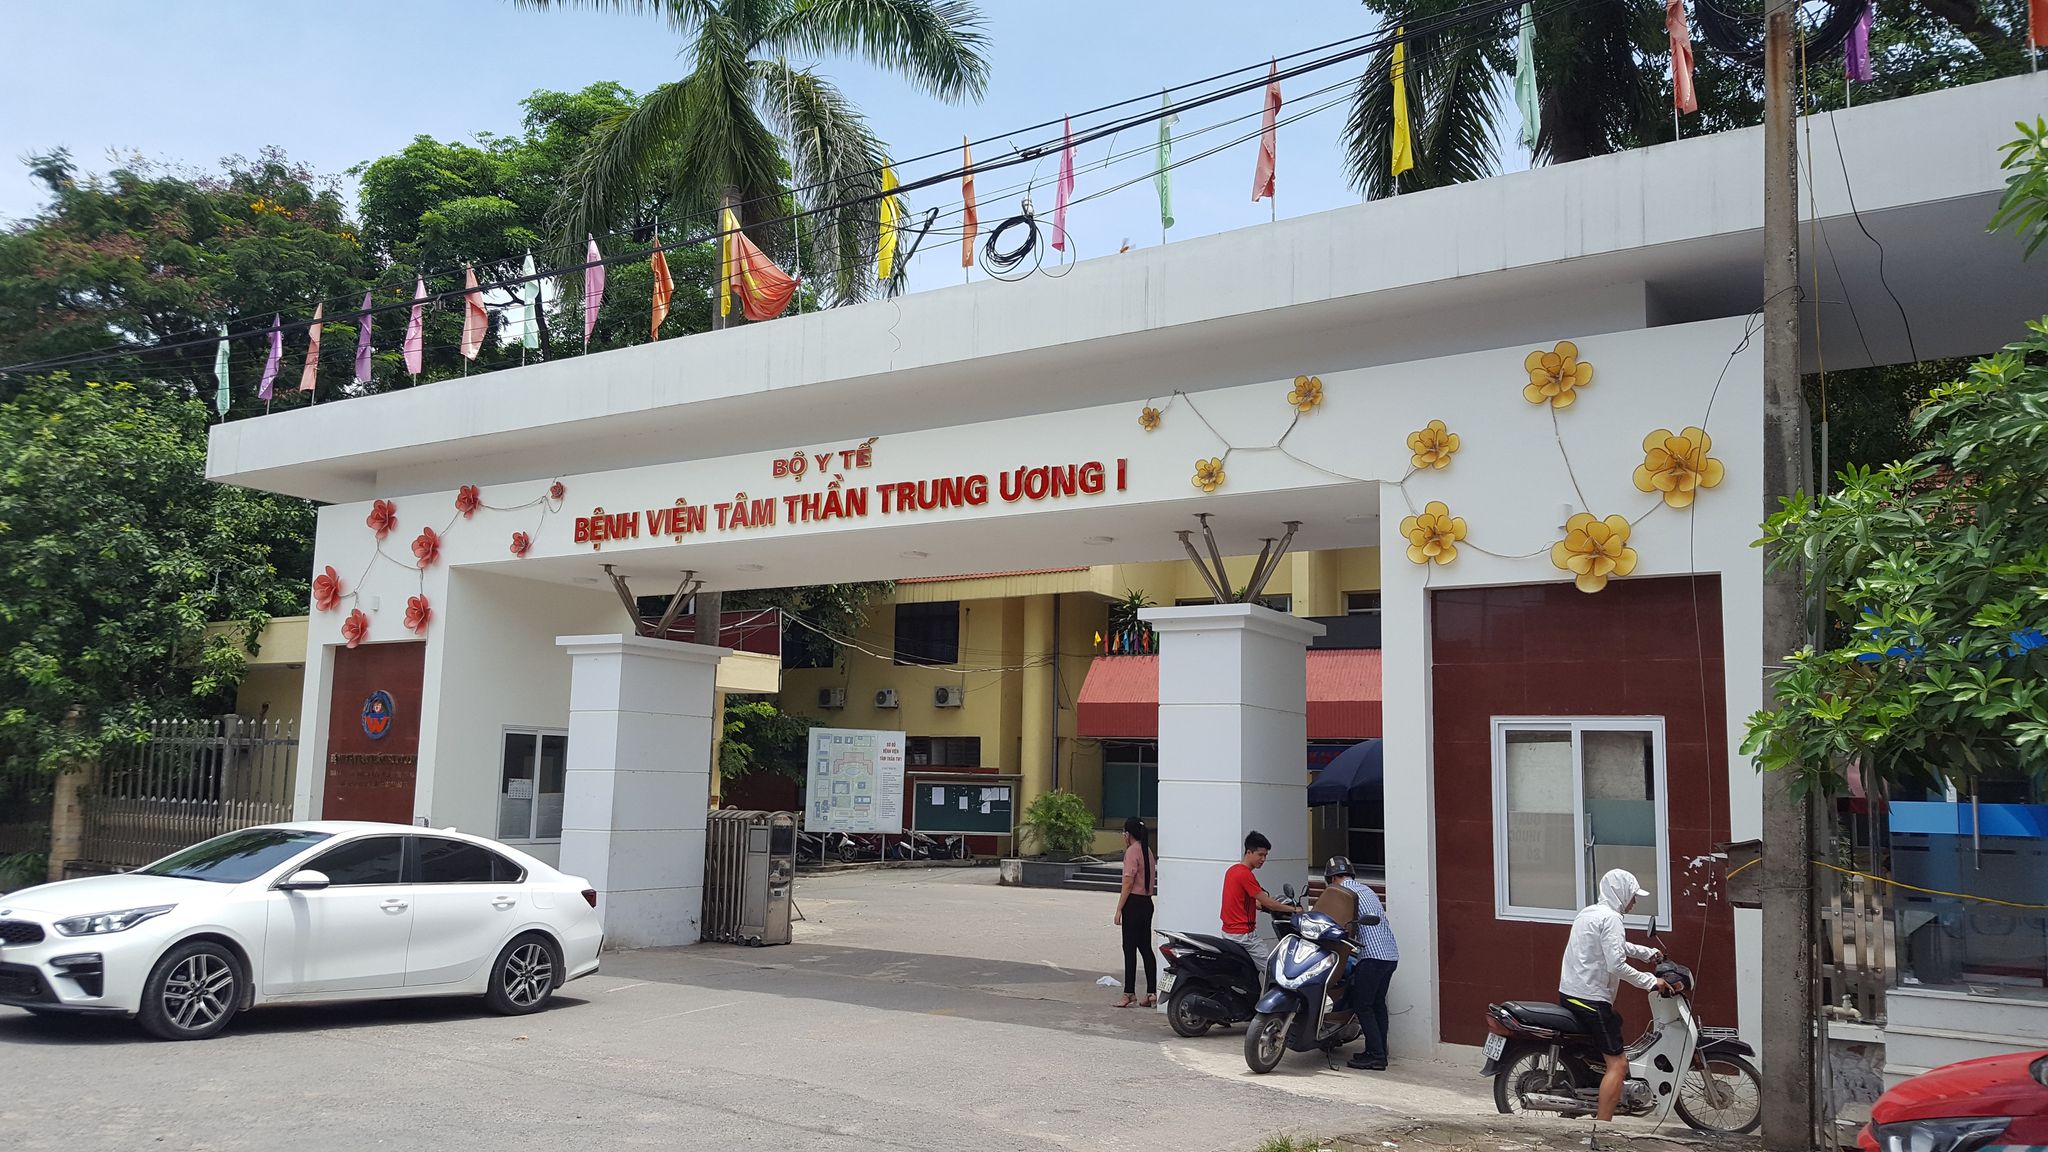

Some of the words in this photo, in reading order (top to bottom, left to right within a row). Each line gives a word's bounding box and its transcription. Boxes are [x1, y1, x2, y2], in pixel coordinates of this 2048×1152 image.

[772, 450, 808, 481] BỘ
[814, 452, 834, 473] Y
[839, 437, 879, 470] TẾ
[573, 507, 641, 550] BỆNH
[646, 497, 708, 543] VIỆN
[713, 491, 777, 531] TÂM
[783, 473, 869, 525] THẦN
[876, 474, 989, 515] TRUNG
[999, 461, 1106, 504] ƯƠNG
[1116, 457, 1128, 492] I
